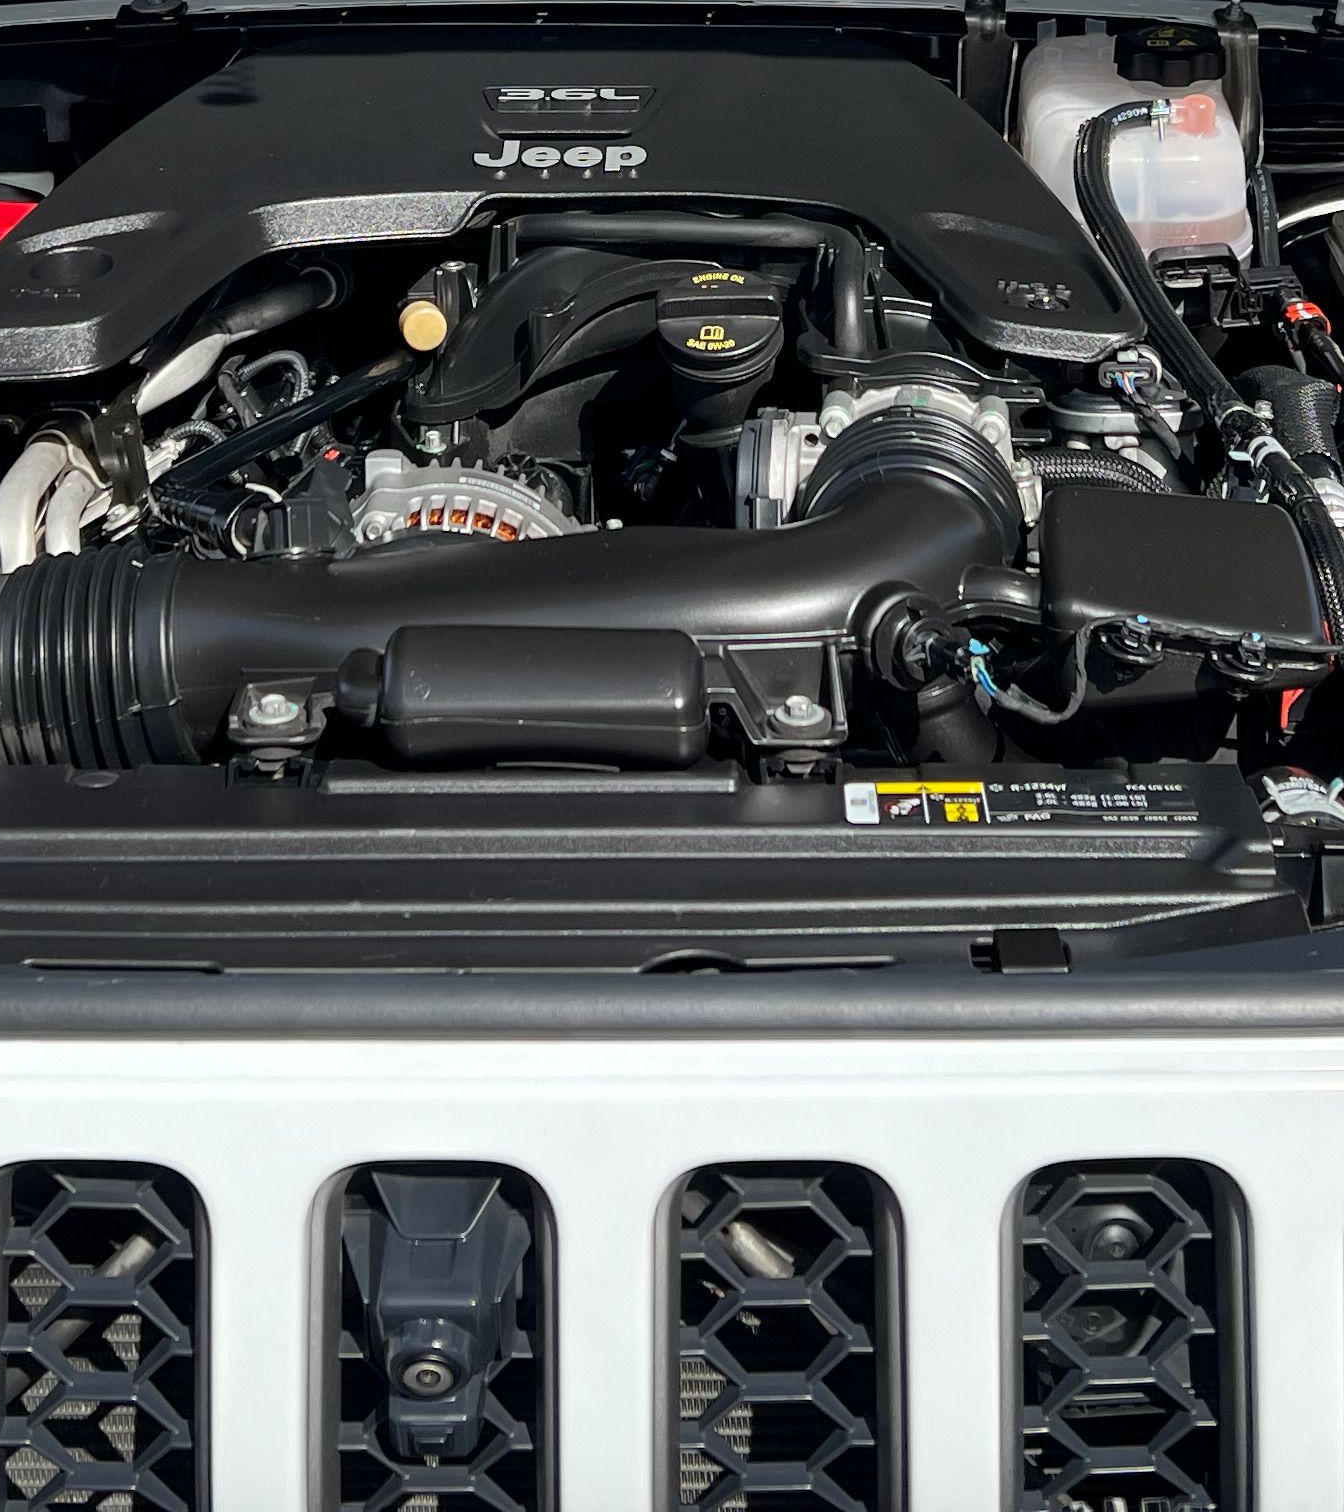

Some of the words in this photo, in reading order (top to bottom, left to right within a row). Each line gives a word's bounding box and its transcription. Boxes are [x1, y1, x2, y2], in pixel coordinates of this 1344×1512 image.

[498, 88, 640, 101] 3.6L
[473, 140, 648, 172] Jeep
[692, 272, 730, 285] ENGINE
[730, 274, 745, 285] OIL
[686, 338, 706, 351] SAE
